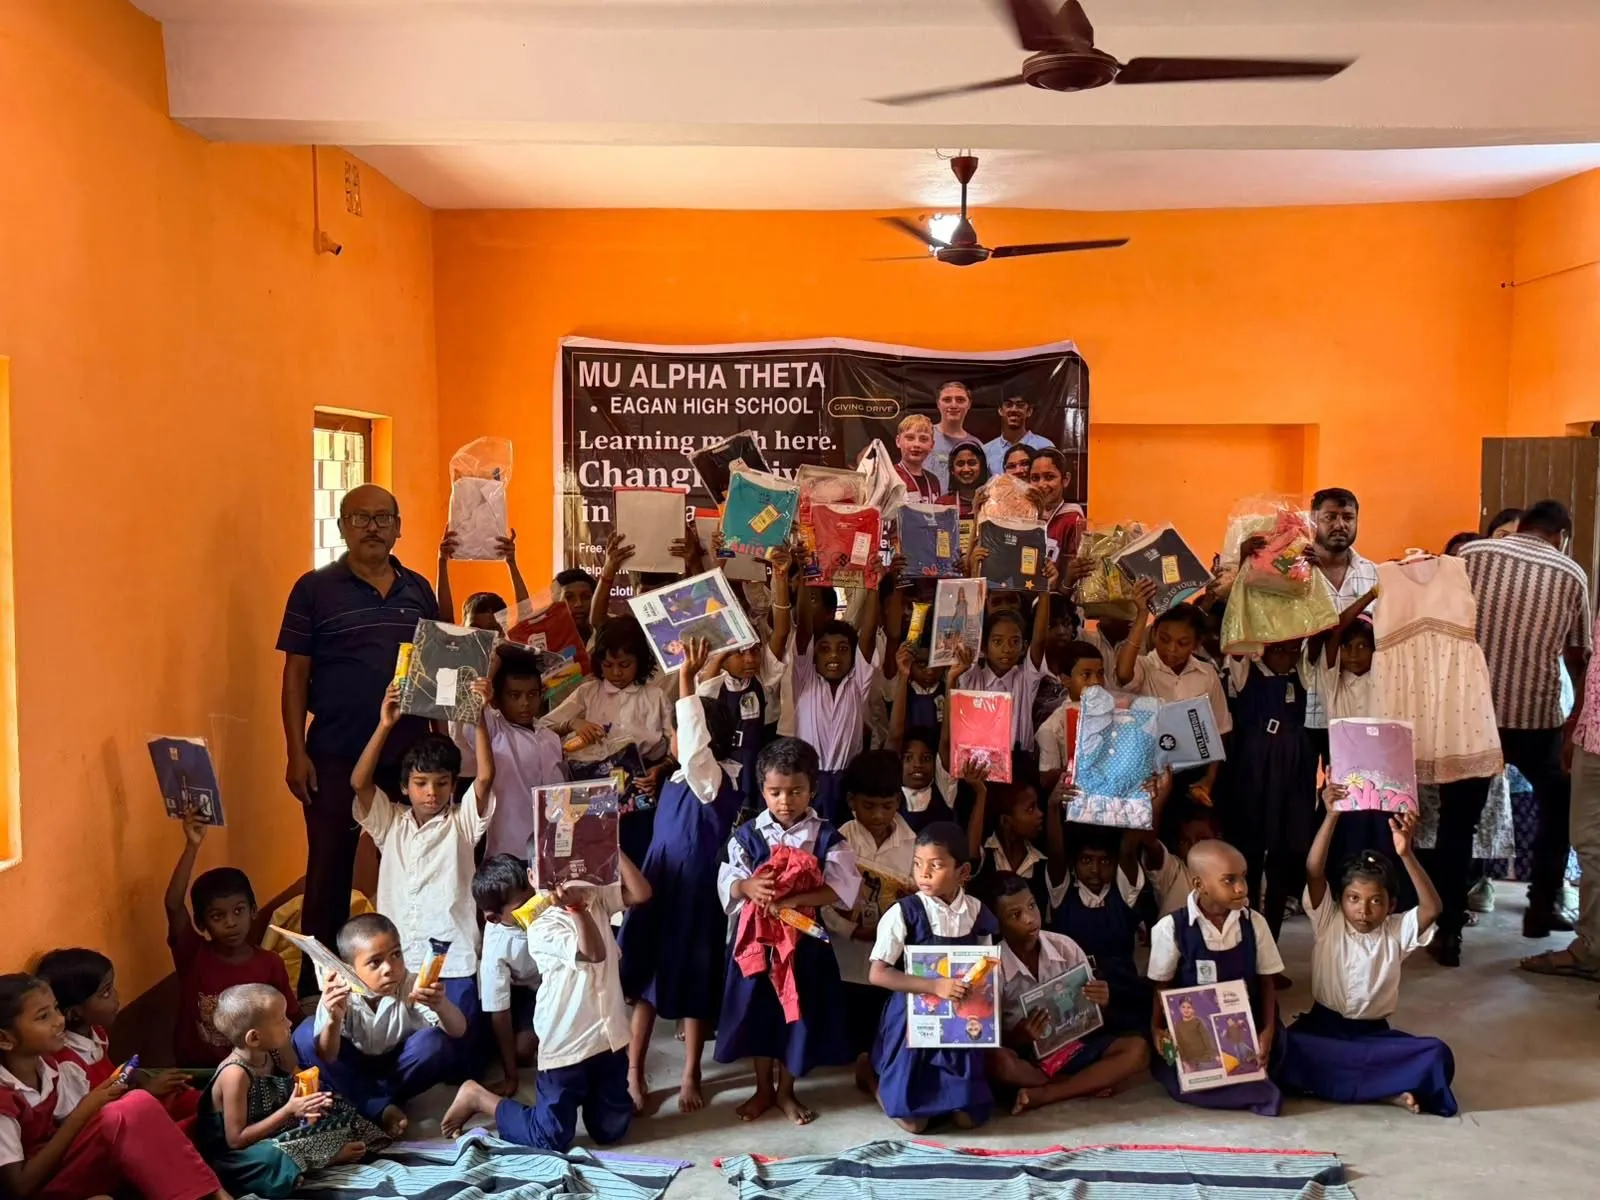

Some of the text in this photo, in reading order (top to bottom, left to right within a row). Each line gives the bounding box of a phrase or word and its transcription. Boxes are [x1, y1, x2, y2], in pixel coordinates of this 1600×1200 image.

[579, 361, 826, 390] MU ALPHA THETA
[610, 396, 814, 414] EAGAN HIGH SCHOOL
[833, 403, 864, 411] GIVING
[578, 430, 696, 455] Learning
[774, 430, 837, 450] here.
[581, 499, 611, 523] in
[578, 542, 606, 555] Free,
